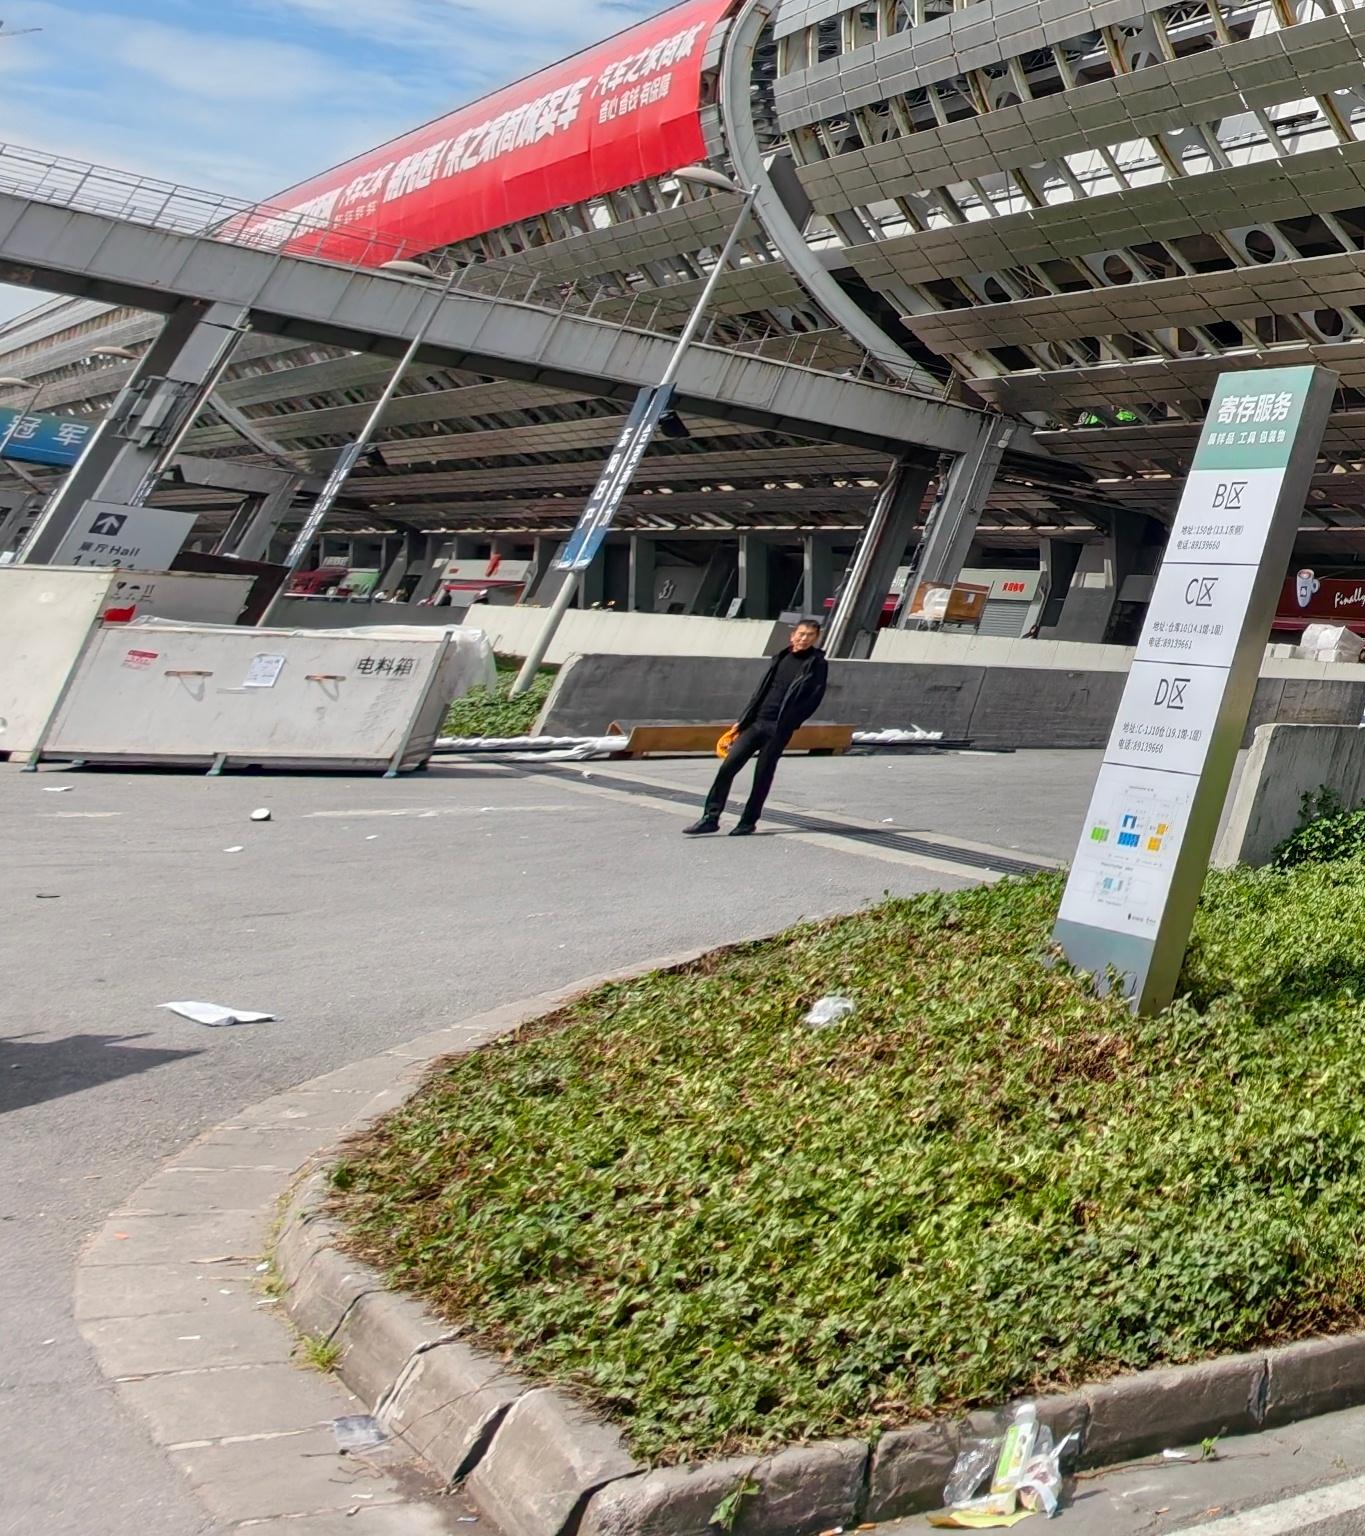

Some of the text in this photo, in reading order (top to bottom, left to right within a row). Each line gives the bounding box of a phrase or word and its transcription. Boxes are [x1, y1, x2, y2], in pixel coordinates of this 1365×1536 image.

[1217, 392, 1293, 424] 寄存服务
[2, 414, 90, 447] 冠军
[1237, 430, 1257, 444] 工具
[1212, 481, 1248, 510] B区
[1185, 577, 1219, 607] C区
[356, 655, 415, 677] 电料箱
[1154, 678, 1191, 711] D区
